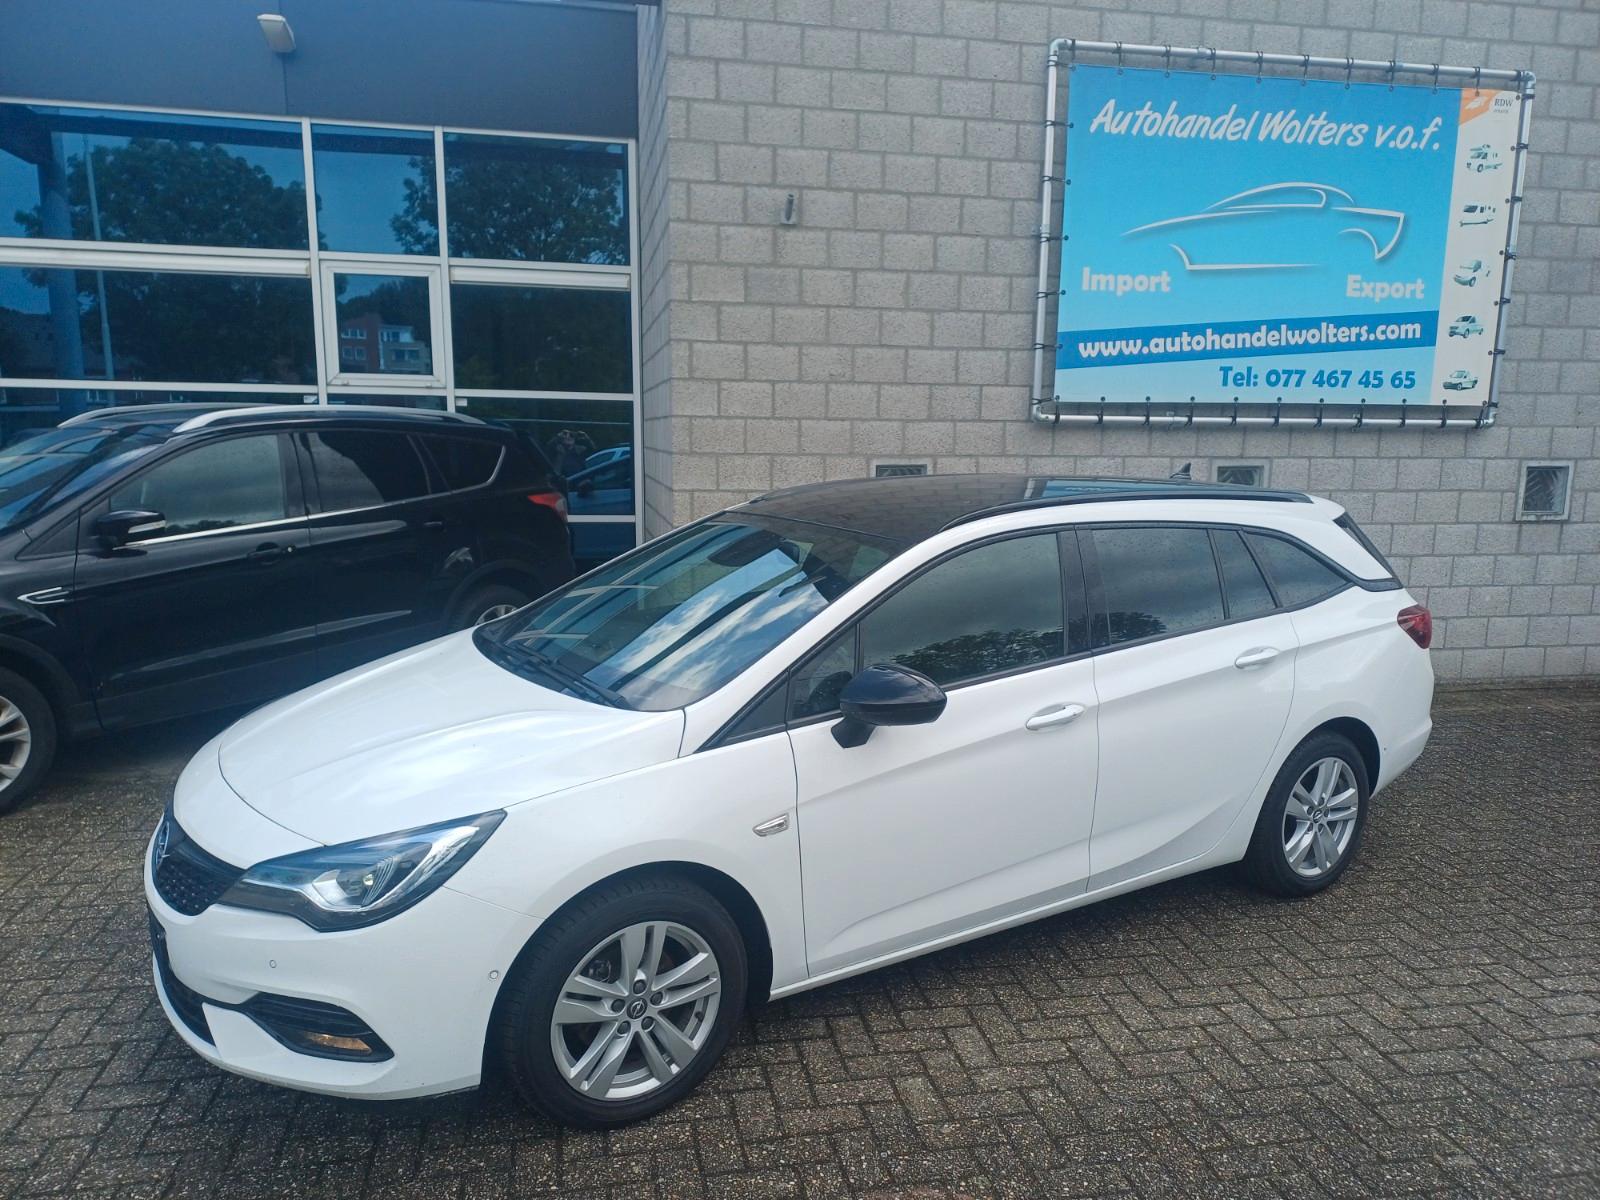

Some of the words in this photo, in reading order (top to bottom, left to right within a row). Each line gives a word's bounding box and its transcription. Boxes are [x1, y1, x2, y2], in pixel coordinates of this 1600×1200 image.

[1494, 98, 1513, 107] RDW
[1089, 98, 1260, 142] Autohandel
[1257, 109, 1369, 147] Wolters
[1374, 116, 1443, 150] v.o.f.
[1082, 266, 1170, 297] Import
[1346, 273, 1425, 304] Export
[1078, 321, 1422, 359] www.autohandelwolters.com
[1219, 366, 1259, 388] Tel:
[1265, 368, 1306, 389] 077
[1312, 369, 1353, 389] 467
[1358, 370, 1384, 389] 45
[1390, 370, 1416, 390] 65
